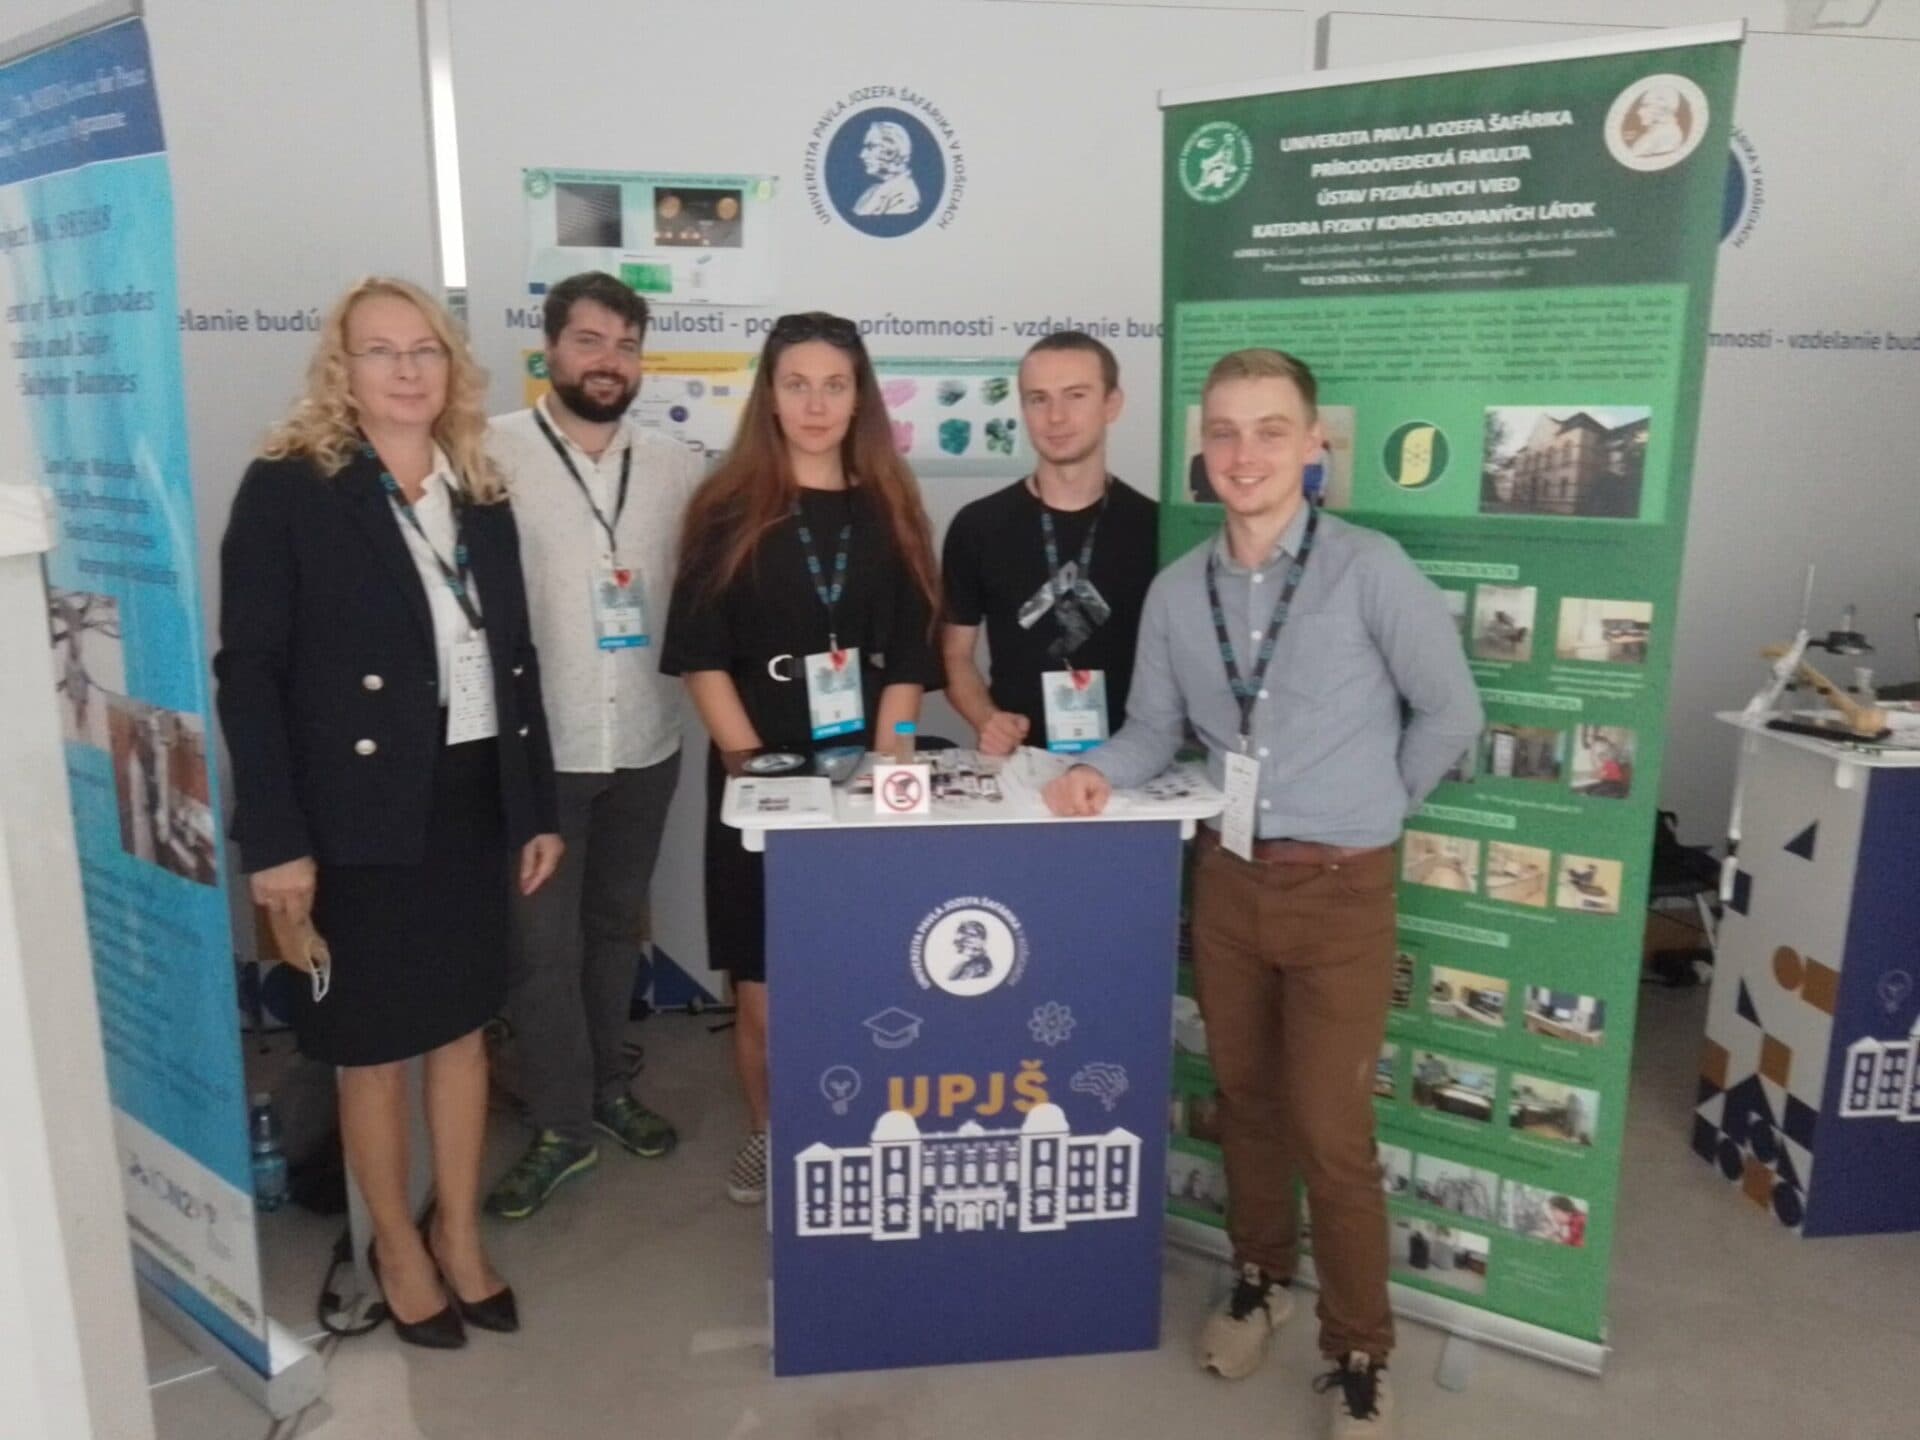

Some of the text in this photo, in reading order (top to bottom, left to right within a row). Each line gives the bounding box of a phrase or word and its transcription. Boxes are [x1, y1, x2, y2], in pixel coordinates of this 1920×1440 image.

[1280, 109, 1574, 152] UNIVERZITA PAVLA JOZEFA ŠAFÁRIKA
[1458, 144, 1532, 165] FAKULTA
[1316, 176, 1521, 206] ÚSTAV FYZIKÁLNYCH VIED
[1252, 200, 1597, 238] KATEDRA FYZIKY KONDENZOVANÝCH LÁTOK
[177, 307, 321, 332] elanie budú
[505, 306, 545, 331] Mú
[647, 310, 724, 333] nulosti
[745, 316, 776, 338] po
[858, 313, 994, 337] prítomnosti
[1013, 315, 1120, 337] vzdelanie
[1708, 329, 1773, 349] mnosti
[886, 1058, 1050, 1118] UPJŠ
